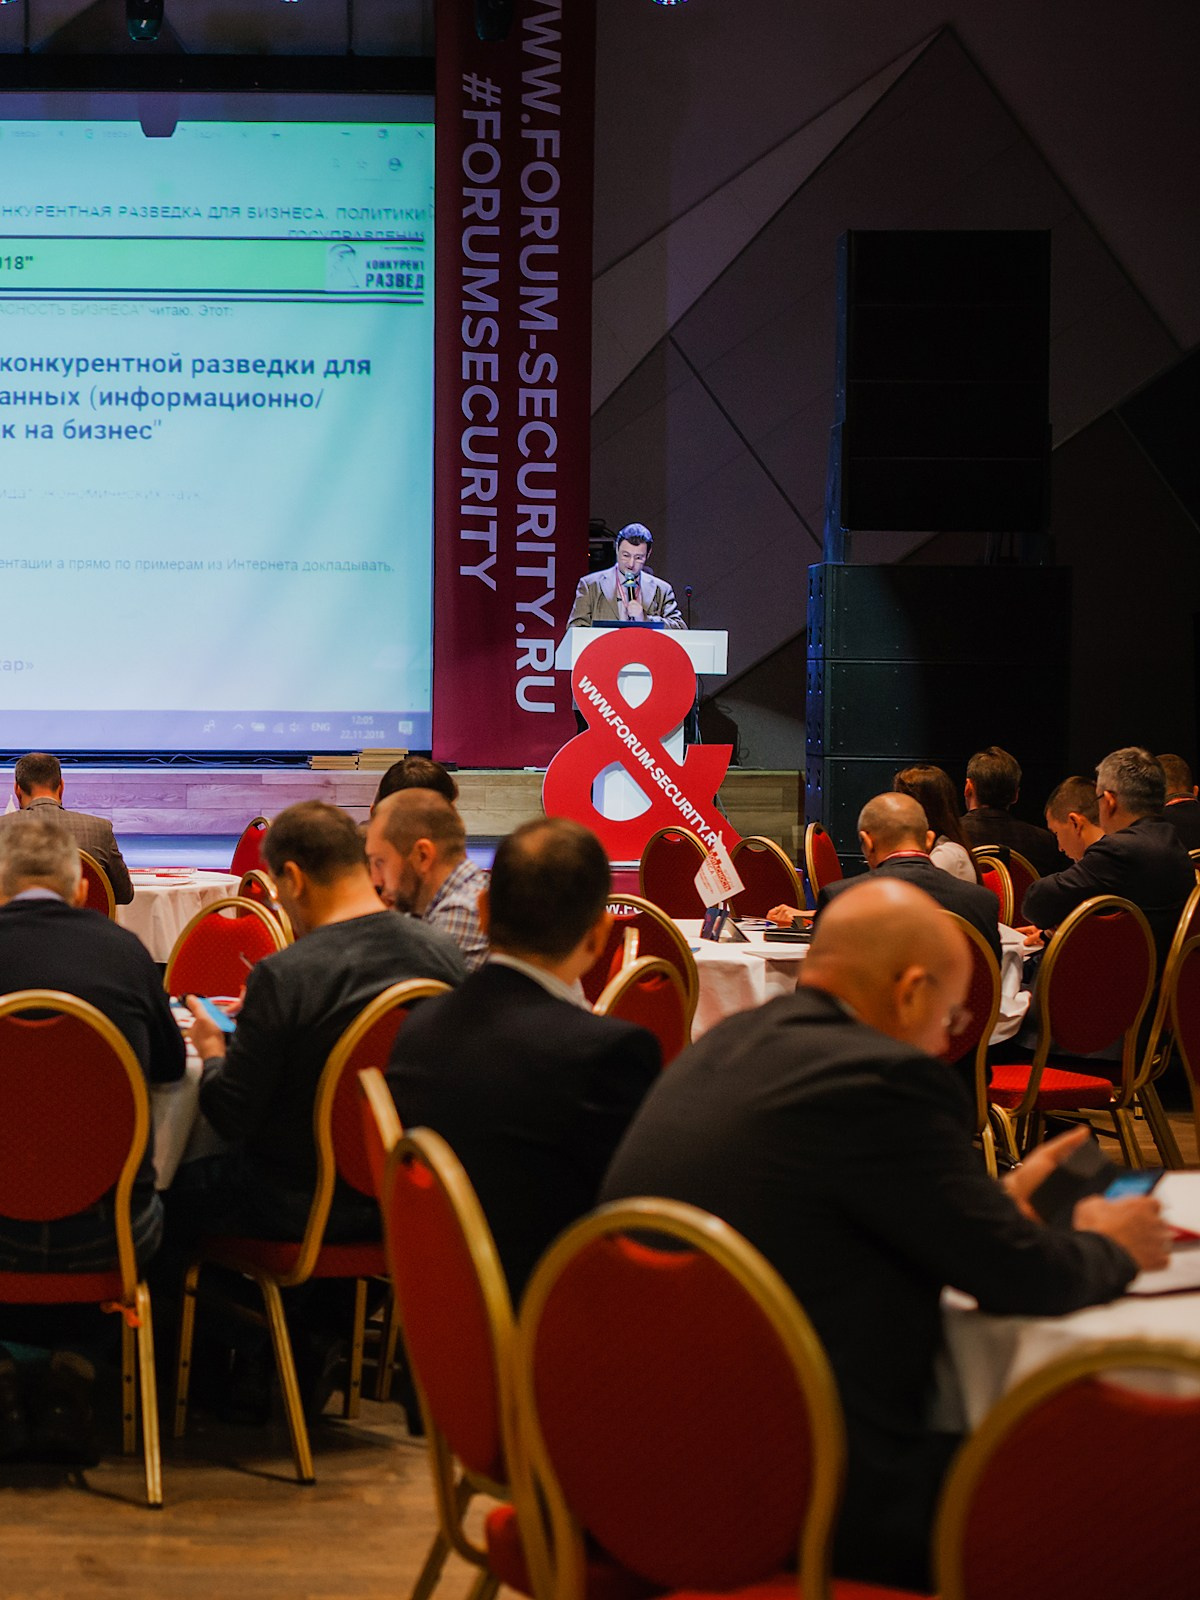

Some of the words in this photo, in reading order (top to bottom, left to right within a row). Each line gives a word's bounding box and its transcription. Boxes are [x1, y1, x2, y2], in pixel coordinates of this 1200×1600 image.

[118, 205, 201, 220] РАЗВЕДКА
[207, 206, 240, 220] ДЛЯ
[460, 72, 502, 592] #FORUMSECURITY
[0, 352, 183, 378] конкурентной
[191, 357, 316, 379] разведки
[323, 357, 372, 378] для
[90, 384, 324, 412] (информационно/
[25, 422, 54, 440] на
[62, 418, 162, 440] бизнес"
[56, 559, 65, 570] а
[69, 559, 112, 572] прямо
[115, 559, 132, 570] по
[135, 559, 204, 573] примерам
[207, 560, 223, 571] из
[227, 558, 299, 573] Интернета
[577, 675, 718, 848] WWW.FORUM-SECURITY.R
